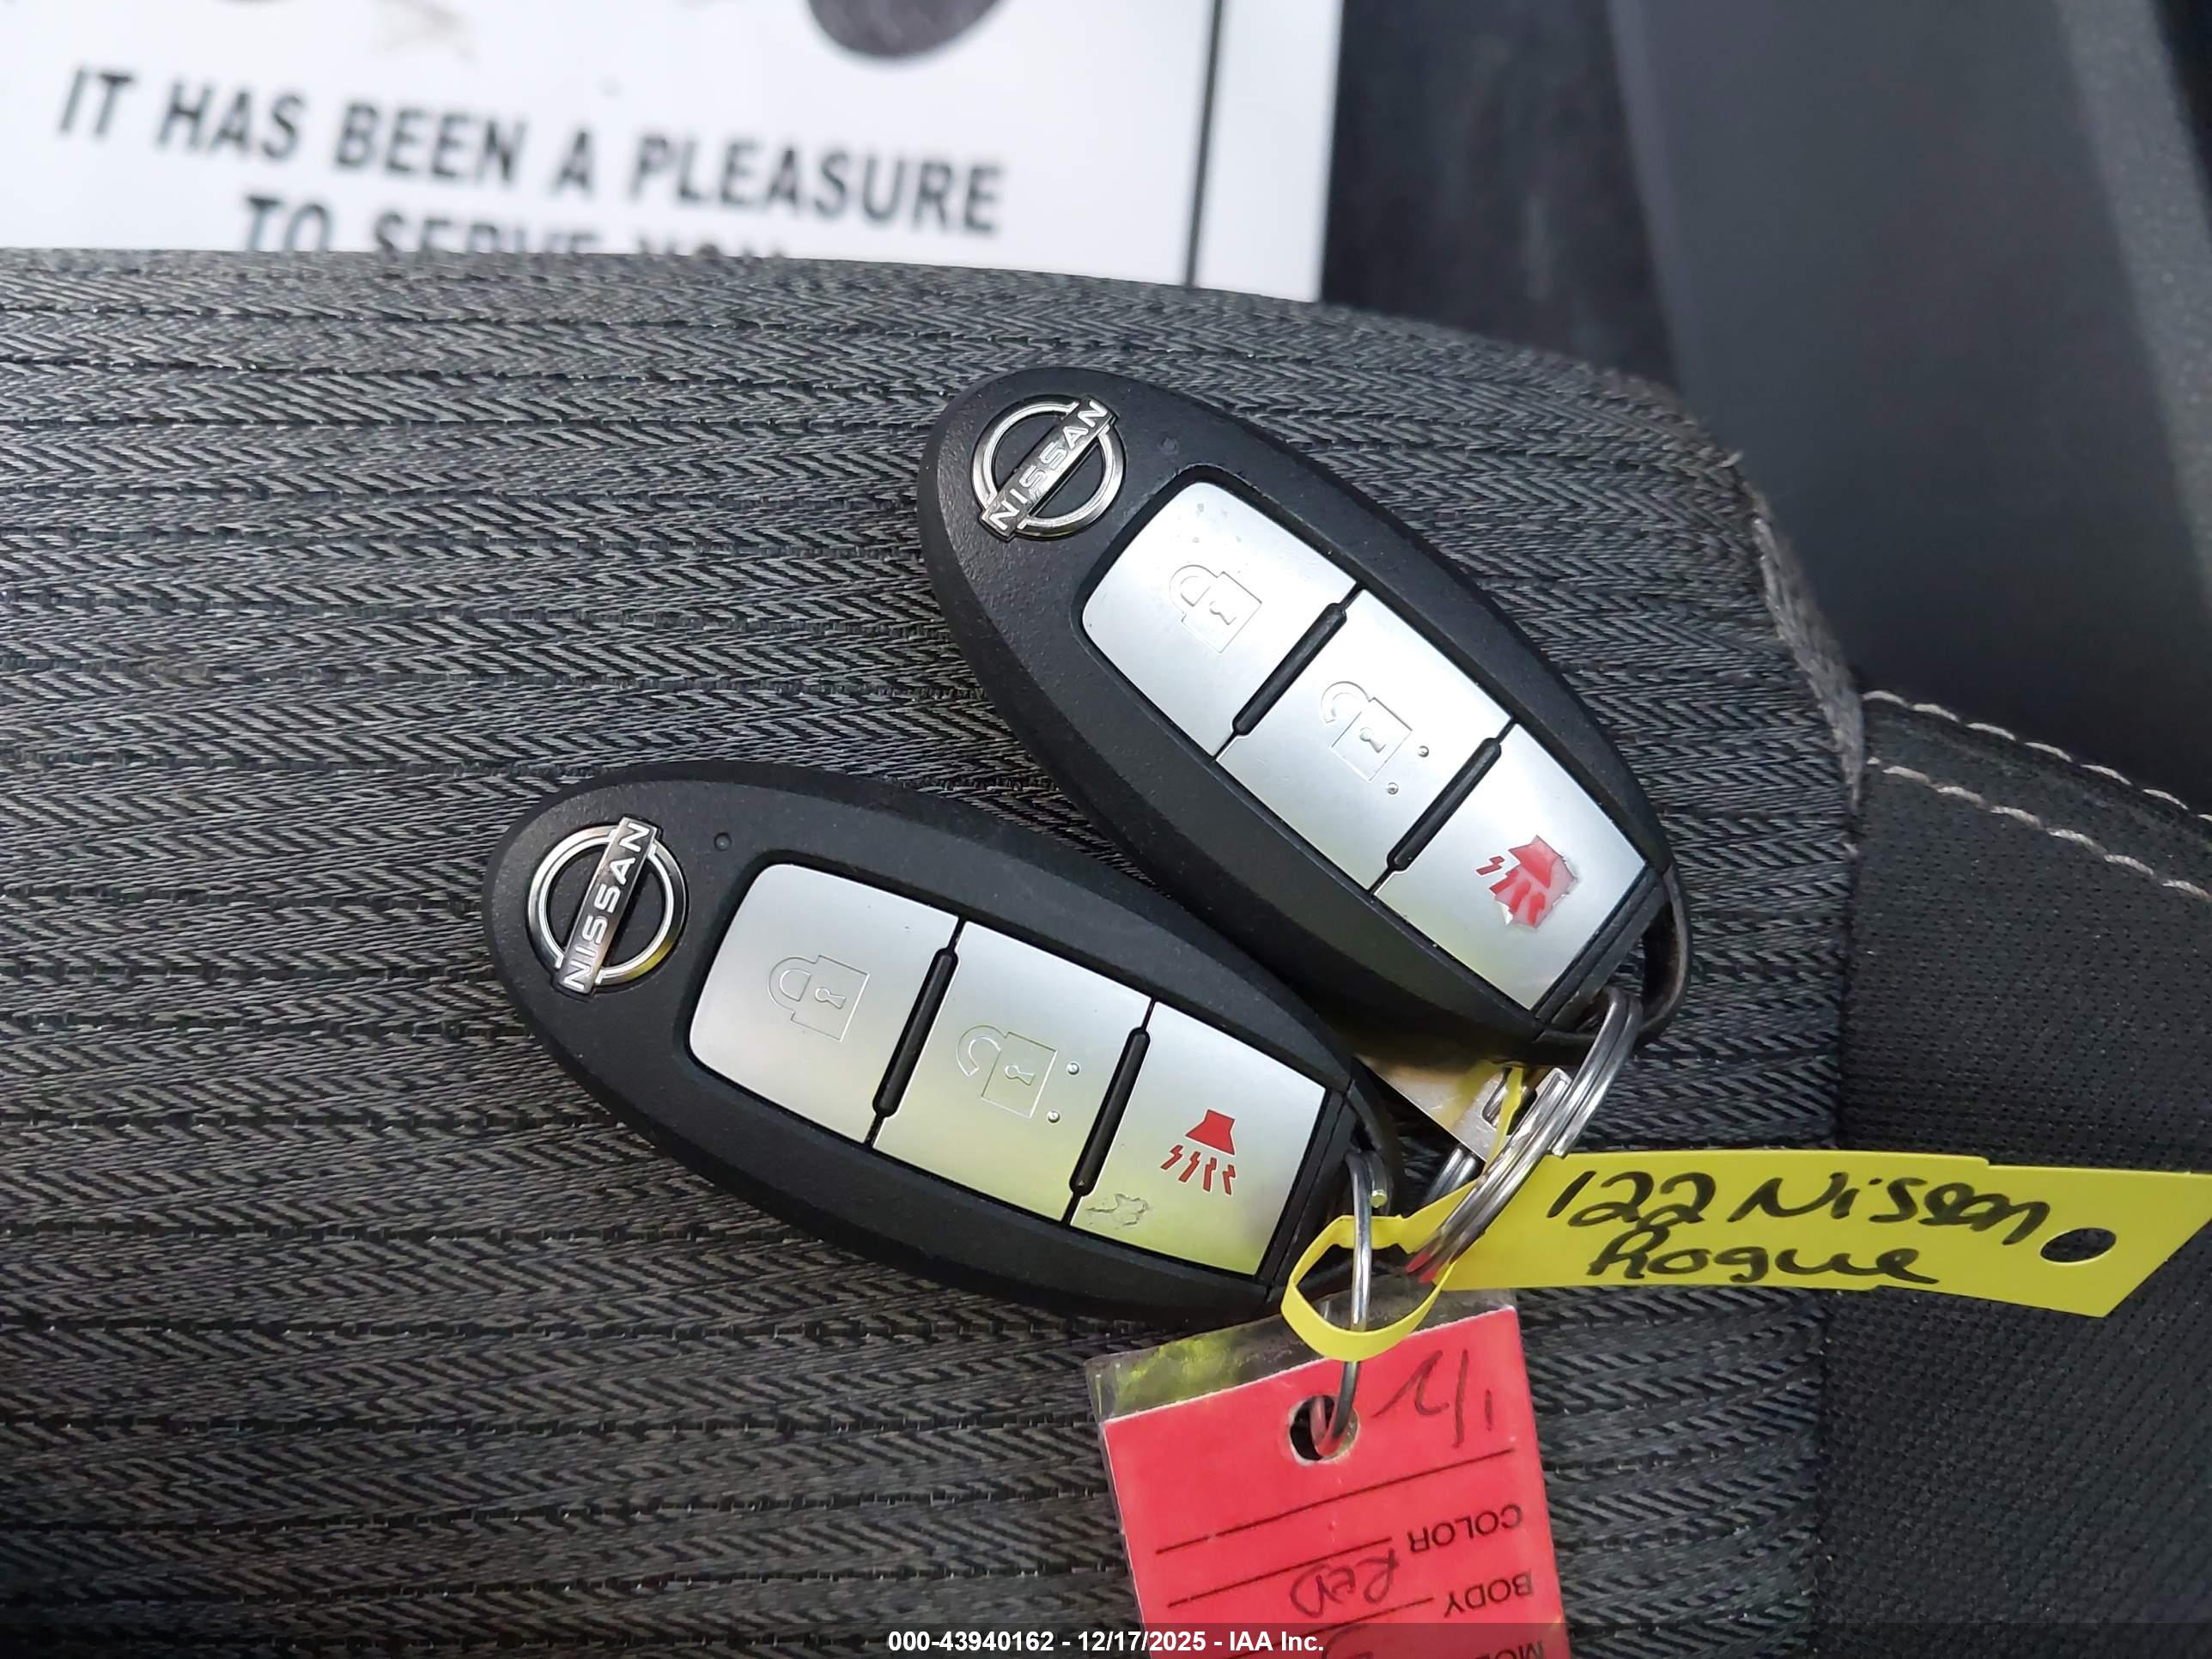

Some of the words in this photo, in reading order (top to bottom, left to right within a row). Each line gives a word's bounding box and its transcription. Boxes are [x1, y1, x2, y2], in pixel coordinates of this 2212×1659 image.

[57, 65, 132, 135] IT
[155, 80, 308, 162] HAS
[333, 99, 527, 186] BEEN
[548, 126, 598, 200] A
[629, 131, 1005, 234] PLEASURE
[244, 194, 332, 252] TO
[989, 399, 1109, 531] NISSAN
[563, 822, 651, 990] NISSAN
[1547, 1170, 1716, 1228] 122
[1407, 1503, 1523, 1553] COLOR
[1443, 1568, 1532, 1619] BODY
